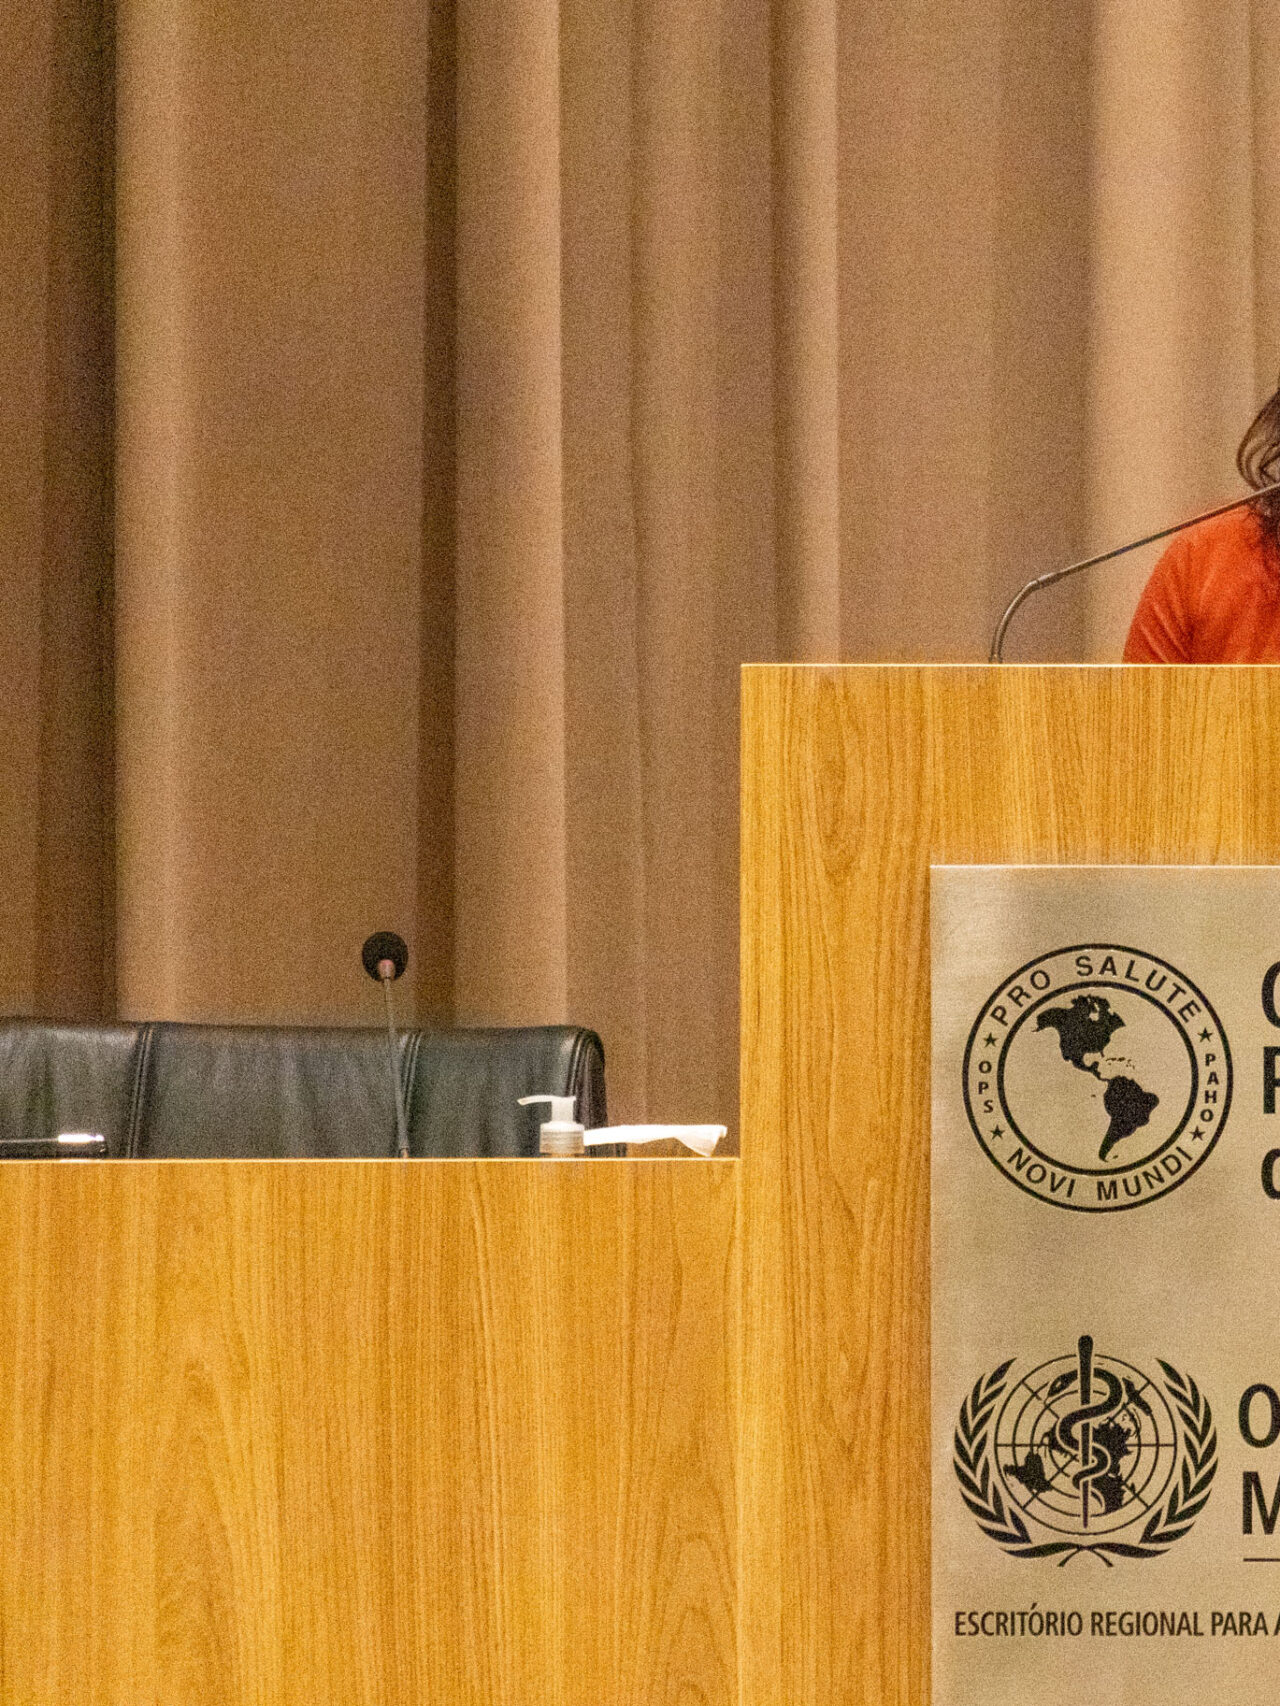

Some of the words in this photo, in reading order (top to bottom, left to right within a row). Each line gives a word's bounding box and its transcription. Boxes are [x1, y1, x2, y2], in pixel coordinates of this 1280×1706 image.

[991, 970, 1050, 1025] PRO
[1076, 956, 1200, 1022] SALUTE
[979, 1061, 993, 1112] OPS
[1201, 1054, 1218, 1121] PAHO
[1008, 1148, 1075, 1197] NOVI
[1097, 1147, 1192, 1200] MUNDI
[956, 1603, 1082, 1636] ESCRITÓRIO
[1091, 1612, 1203, 1636] REGIONAL
[1212, 1612, 1268, 1635] PARA
